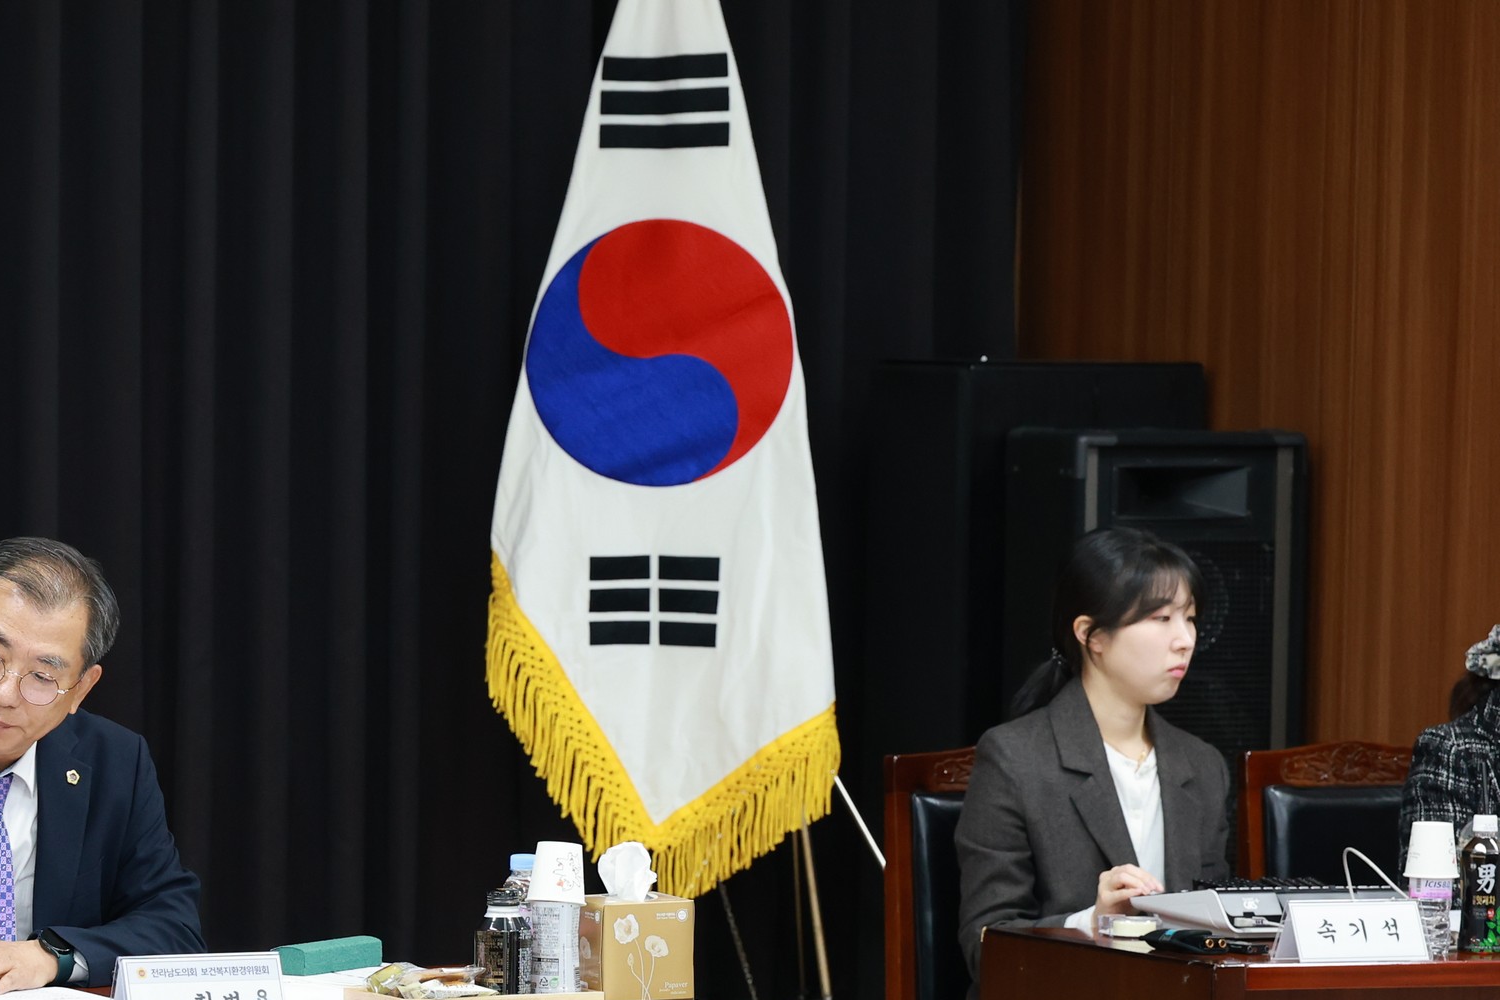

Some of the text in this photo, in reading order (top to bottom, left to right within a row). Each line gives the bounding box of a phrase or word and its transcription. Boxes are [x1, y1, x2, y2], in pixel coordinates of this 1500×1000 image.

[1425, 880, 1442, 888] ICIS
[1476, 863, 1497, 894] 男
[151, 965, 270, 978] 전라남도의회 보건복지환경위원회
